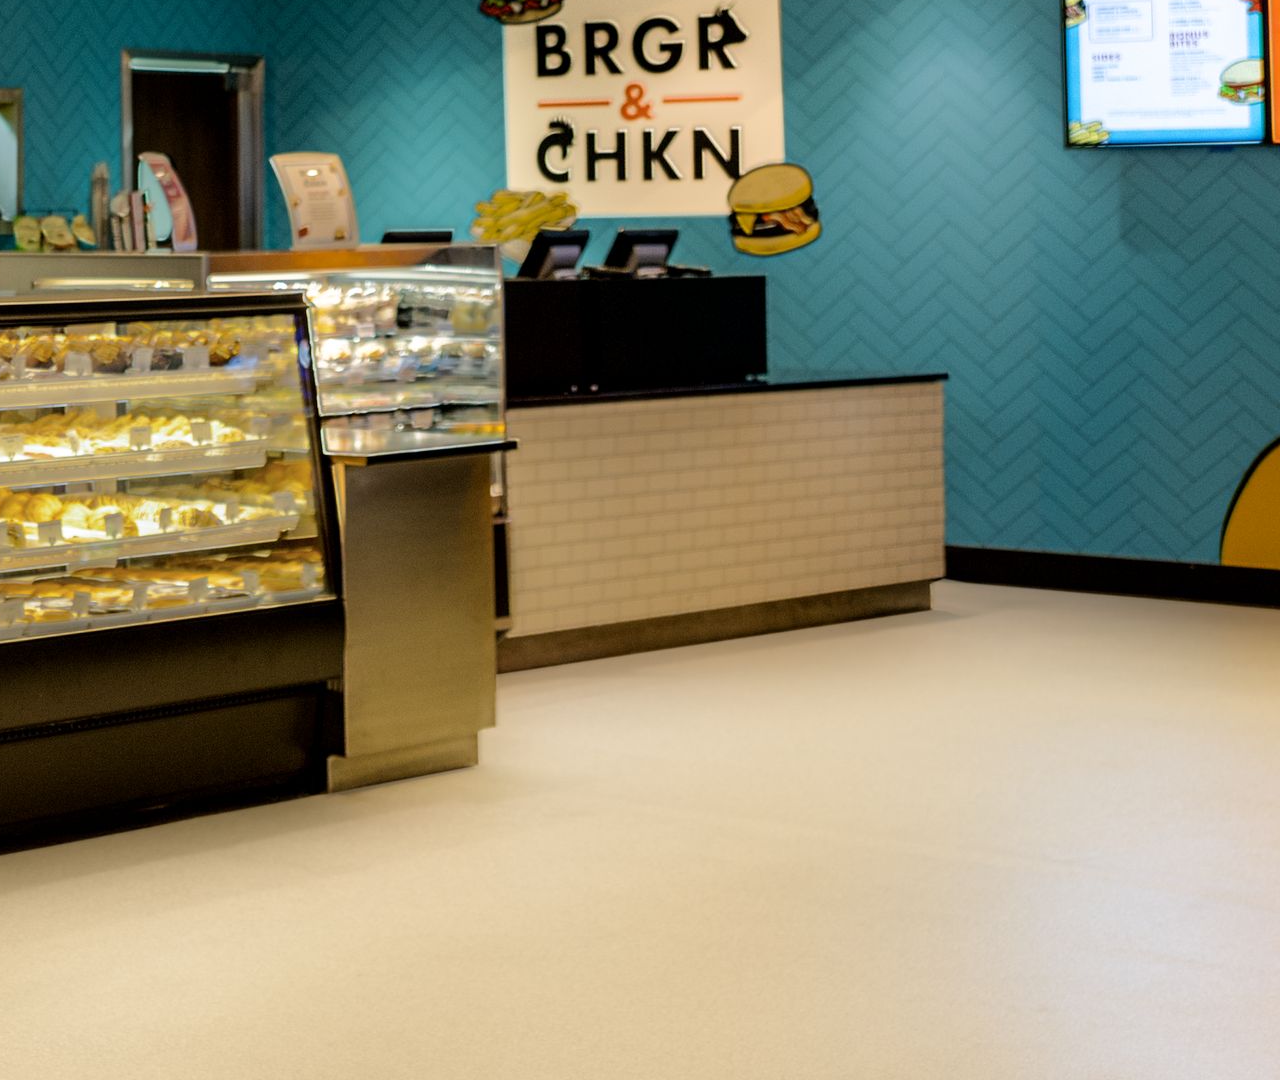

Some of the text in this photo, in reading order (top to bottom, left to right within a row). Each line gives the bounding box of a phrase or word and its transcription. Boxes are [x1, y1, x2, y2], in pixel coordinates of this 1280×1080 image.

[536, 4, 748, 78] BRGR
[620, 83, 653, 121] &
[536, 114, 744, 184] CHKN
